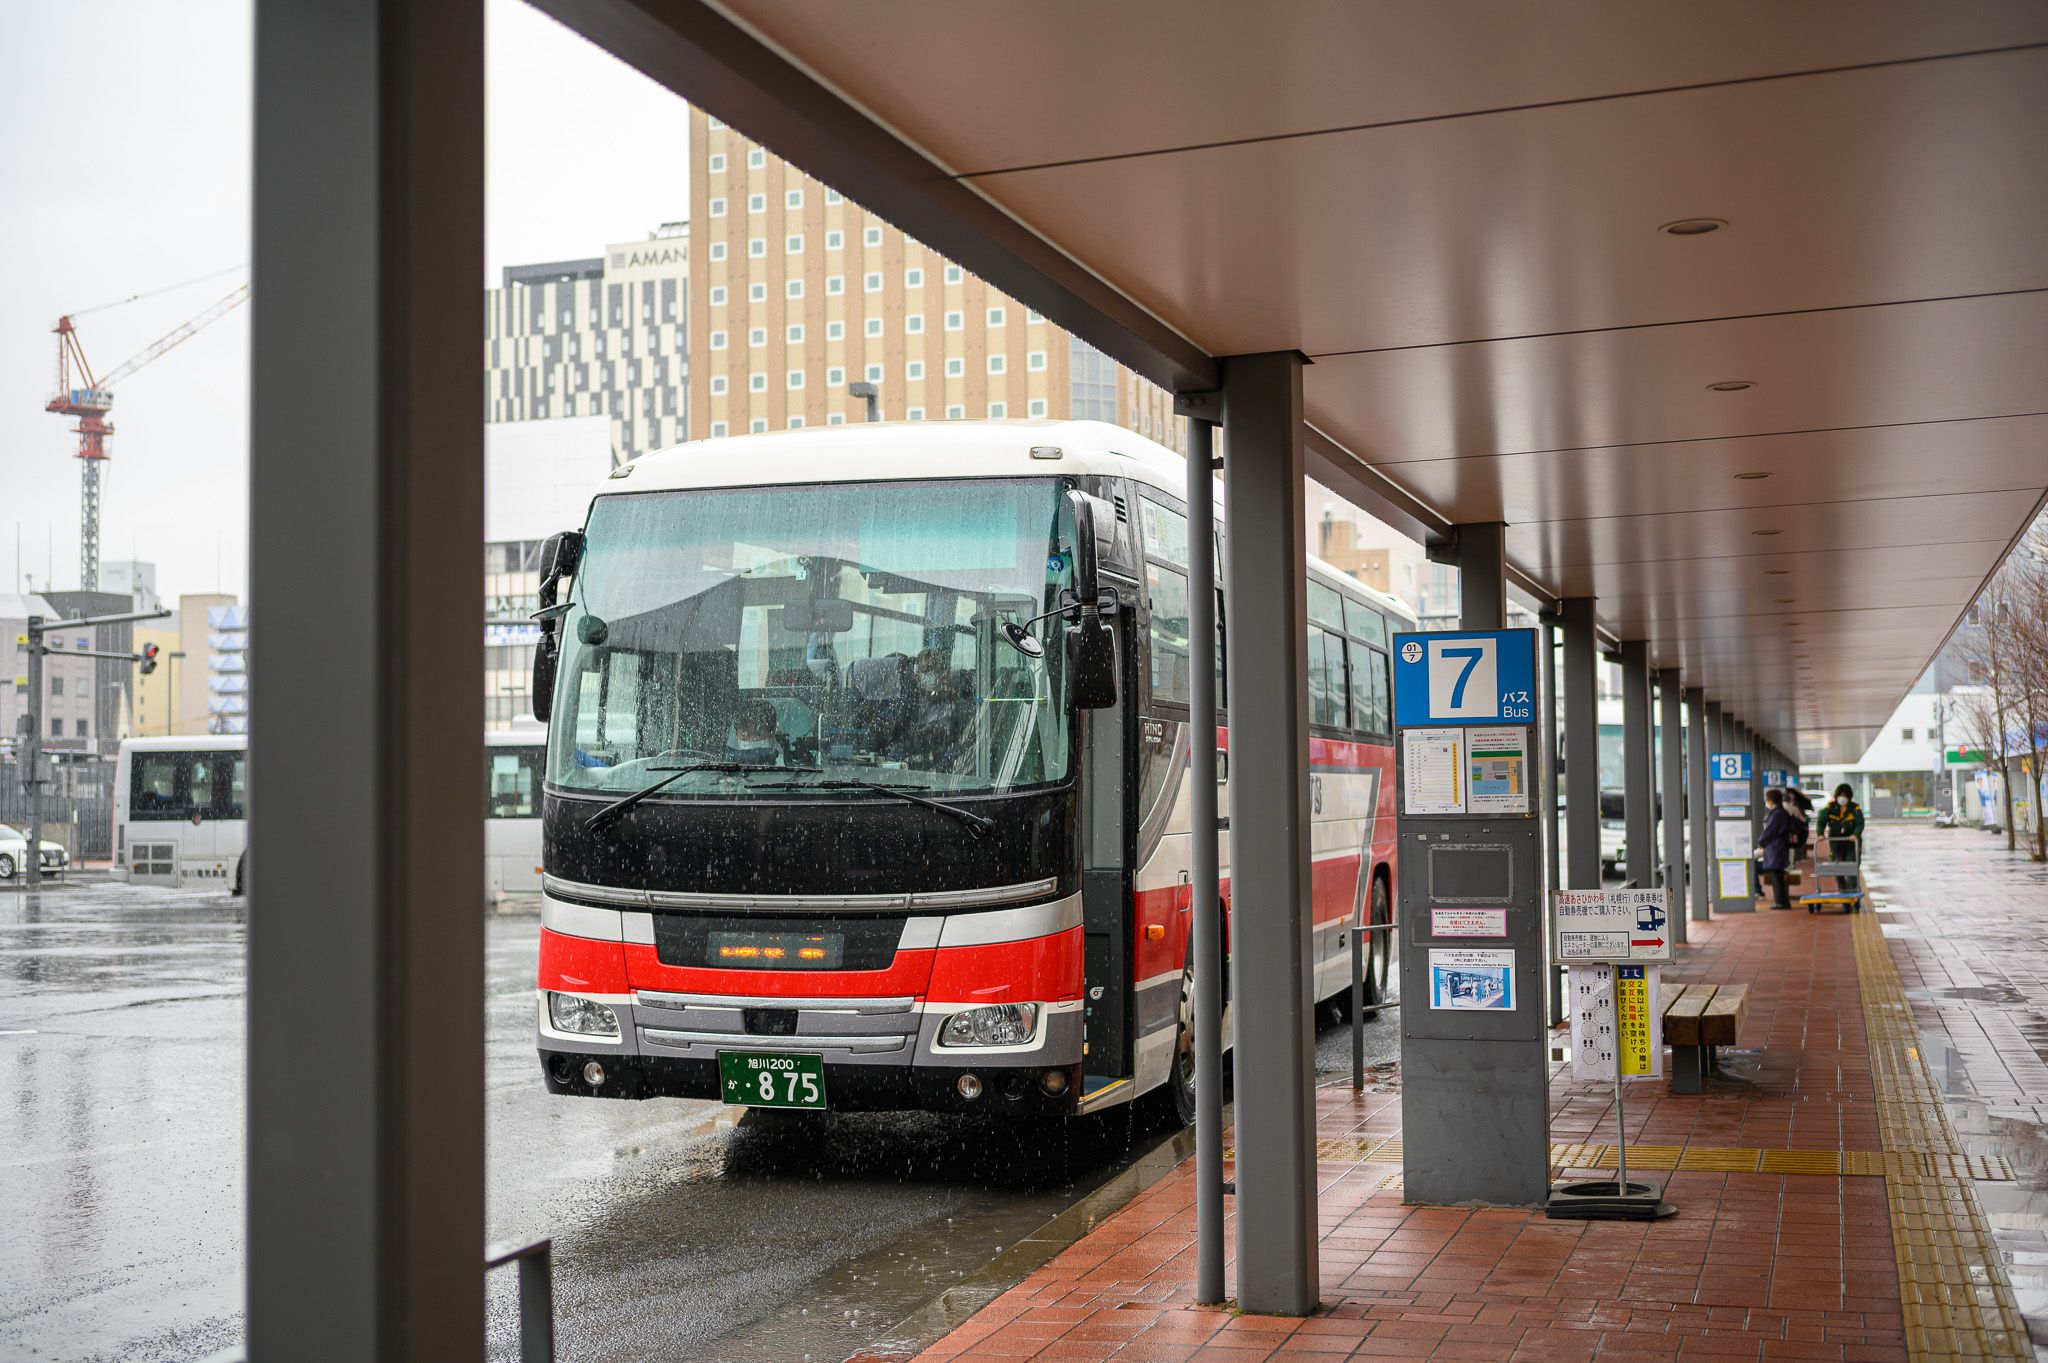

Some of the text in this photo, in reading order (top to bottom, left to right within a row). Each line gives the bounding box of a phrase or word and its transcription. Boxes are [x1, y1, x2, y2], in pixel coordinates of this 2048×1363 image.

[1406, 644, 1417, 652] 01
[1409, 654, 1415, 662] 7
[1441, 647, 1483, 708] 7
[1502, 691, 1530, 704] バス
[1503, 706, 1529, 718] Bus
[1144, 722, 1163, 737] HINO
[1724, 757, 1738, 776] 8
[1620, 981, 1630, 1040] お並びください。
[1628, 980, 1638, 1053] 交互に間隔を空けて
[1637, 980, 1647, 1071] 2列以上でお待ちの際は
[728, 1080, 738, 1090] か
